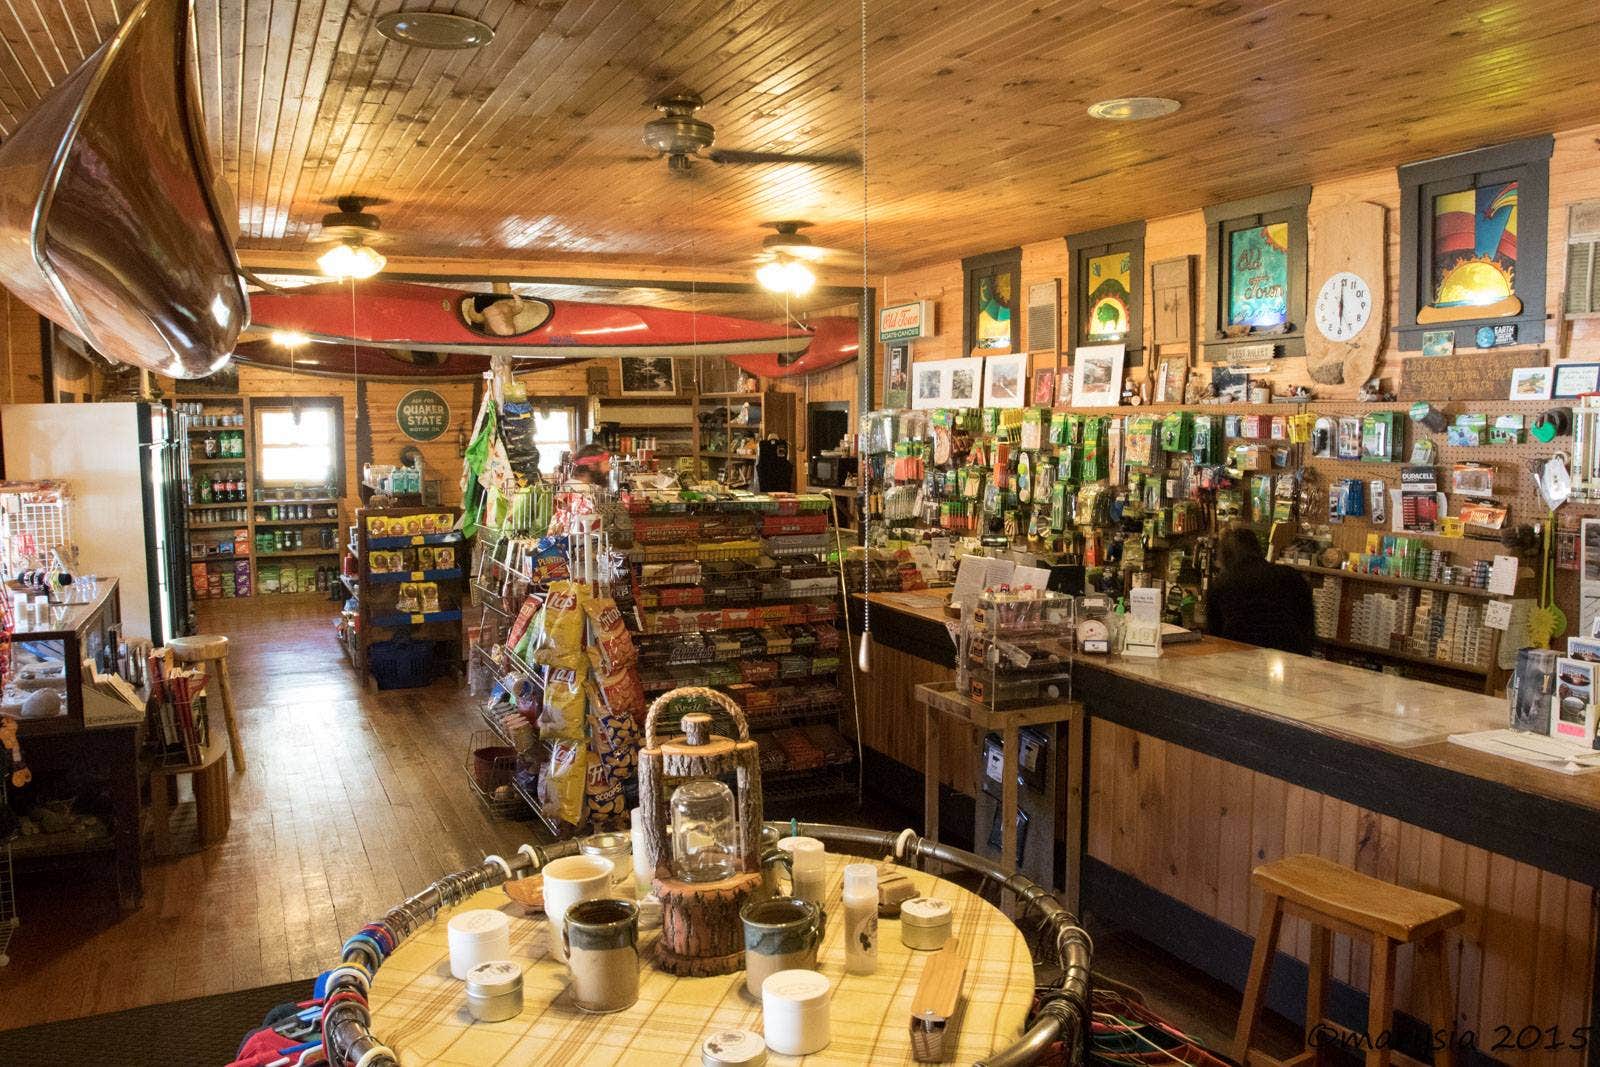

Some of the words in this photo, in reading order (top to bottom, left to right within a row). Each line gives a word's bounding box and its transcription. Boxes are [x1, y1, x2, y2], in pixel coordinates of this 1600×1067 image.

[1237, 247, 1263, 272] Old
[1244, 275, 1286, 300] Town
[883, 312, 898, 329] Old
[898, 308, 918, 327] Town
[403, 405, 444, 416] QUAKER
[407, 415, 442, 426] STATE
[1402, 472, 1434, 480] DURACELL
